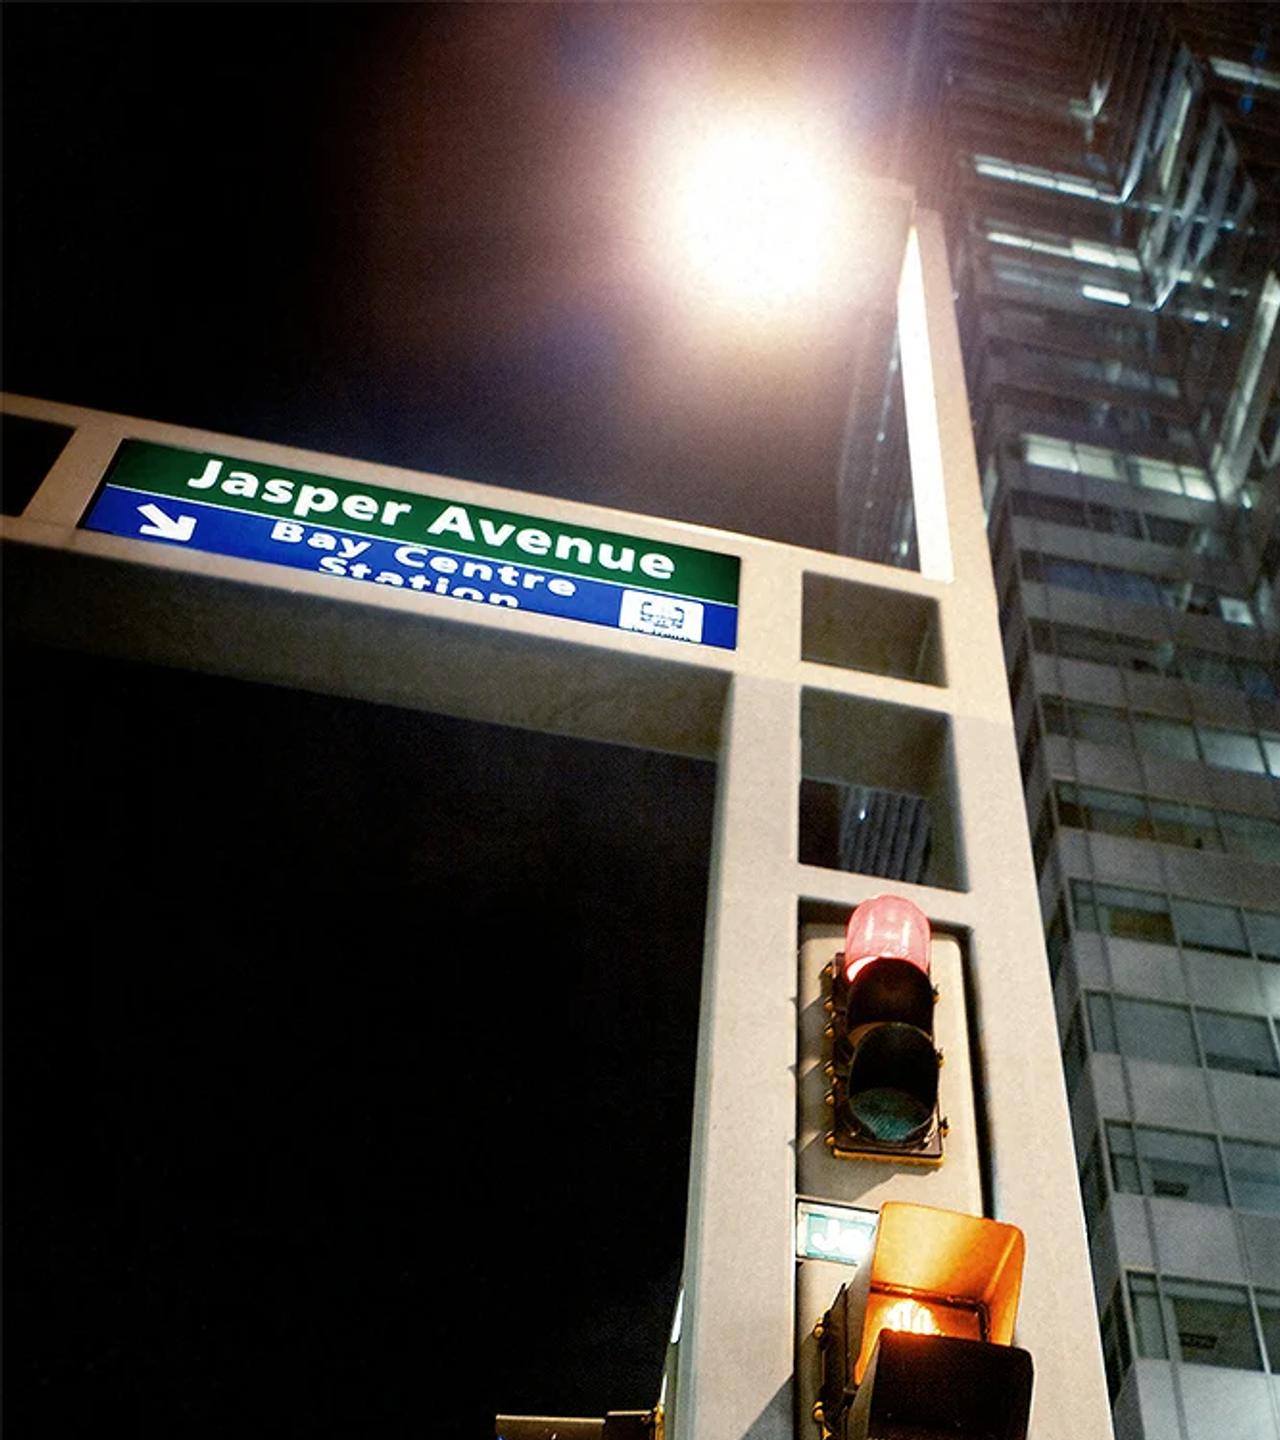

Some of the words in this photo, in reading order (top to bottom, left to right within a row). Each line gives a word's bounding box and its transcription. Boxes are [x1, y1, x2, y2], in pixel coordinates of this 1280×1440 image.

[187, 460, 412, 525] Jasper
[427, 505, 675, 580] Avenue
[271, 521, 371, 558] Bay
[394, 545, 577, 597] Centre
